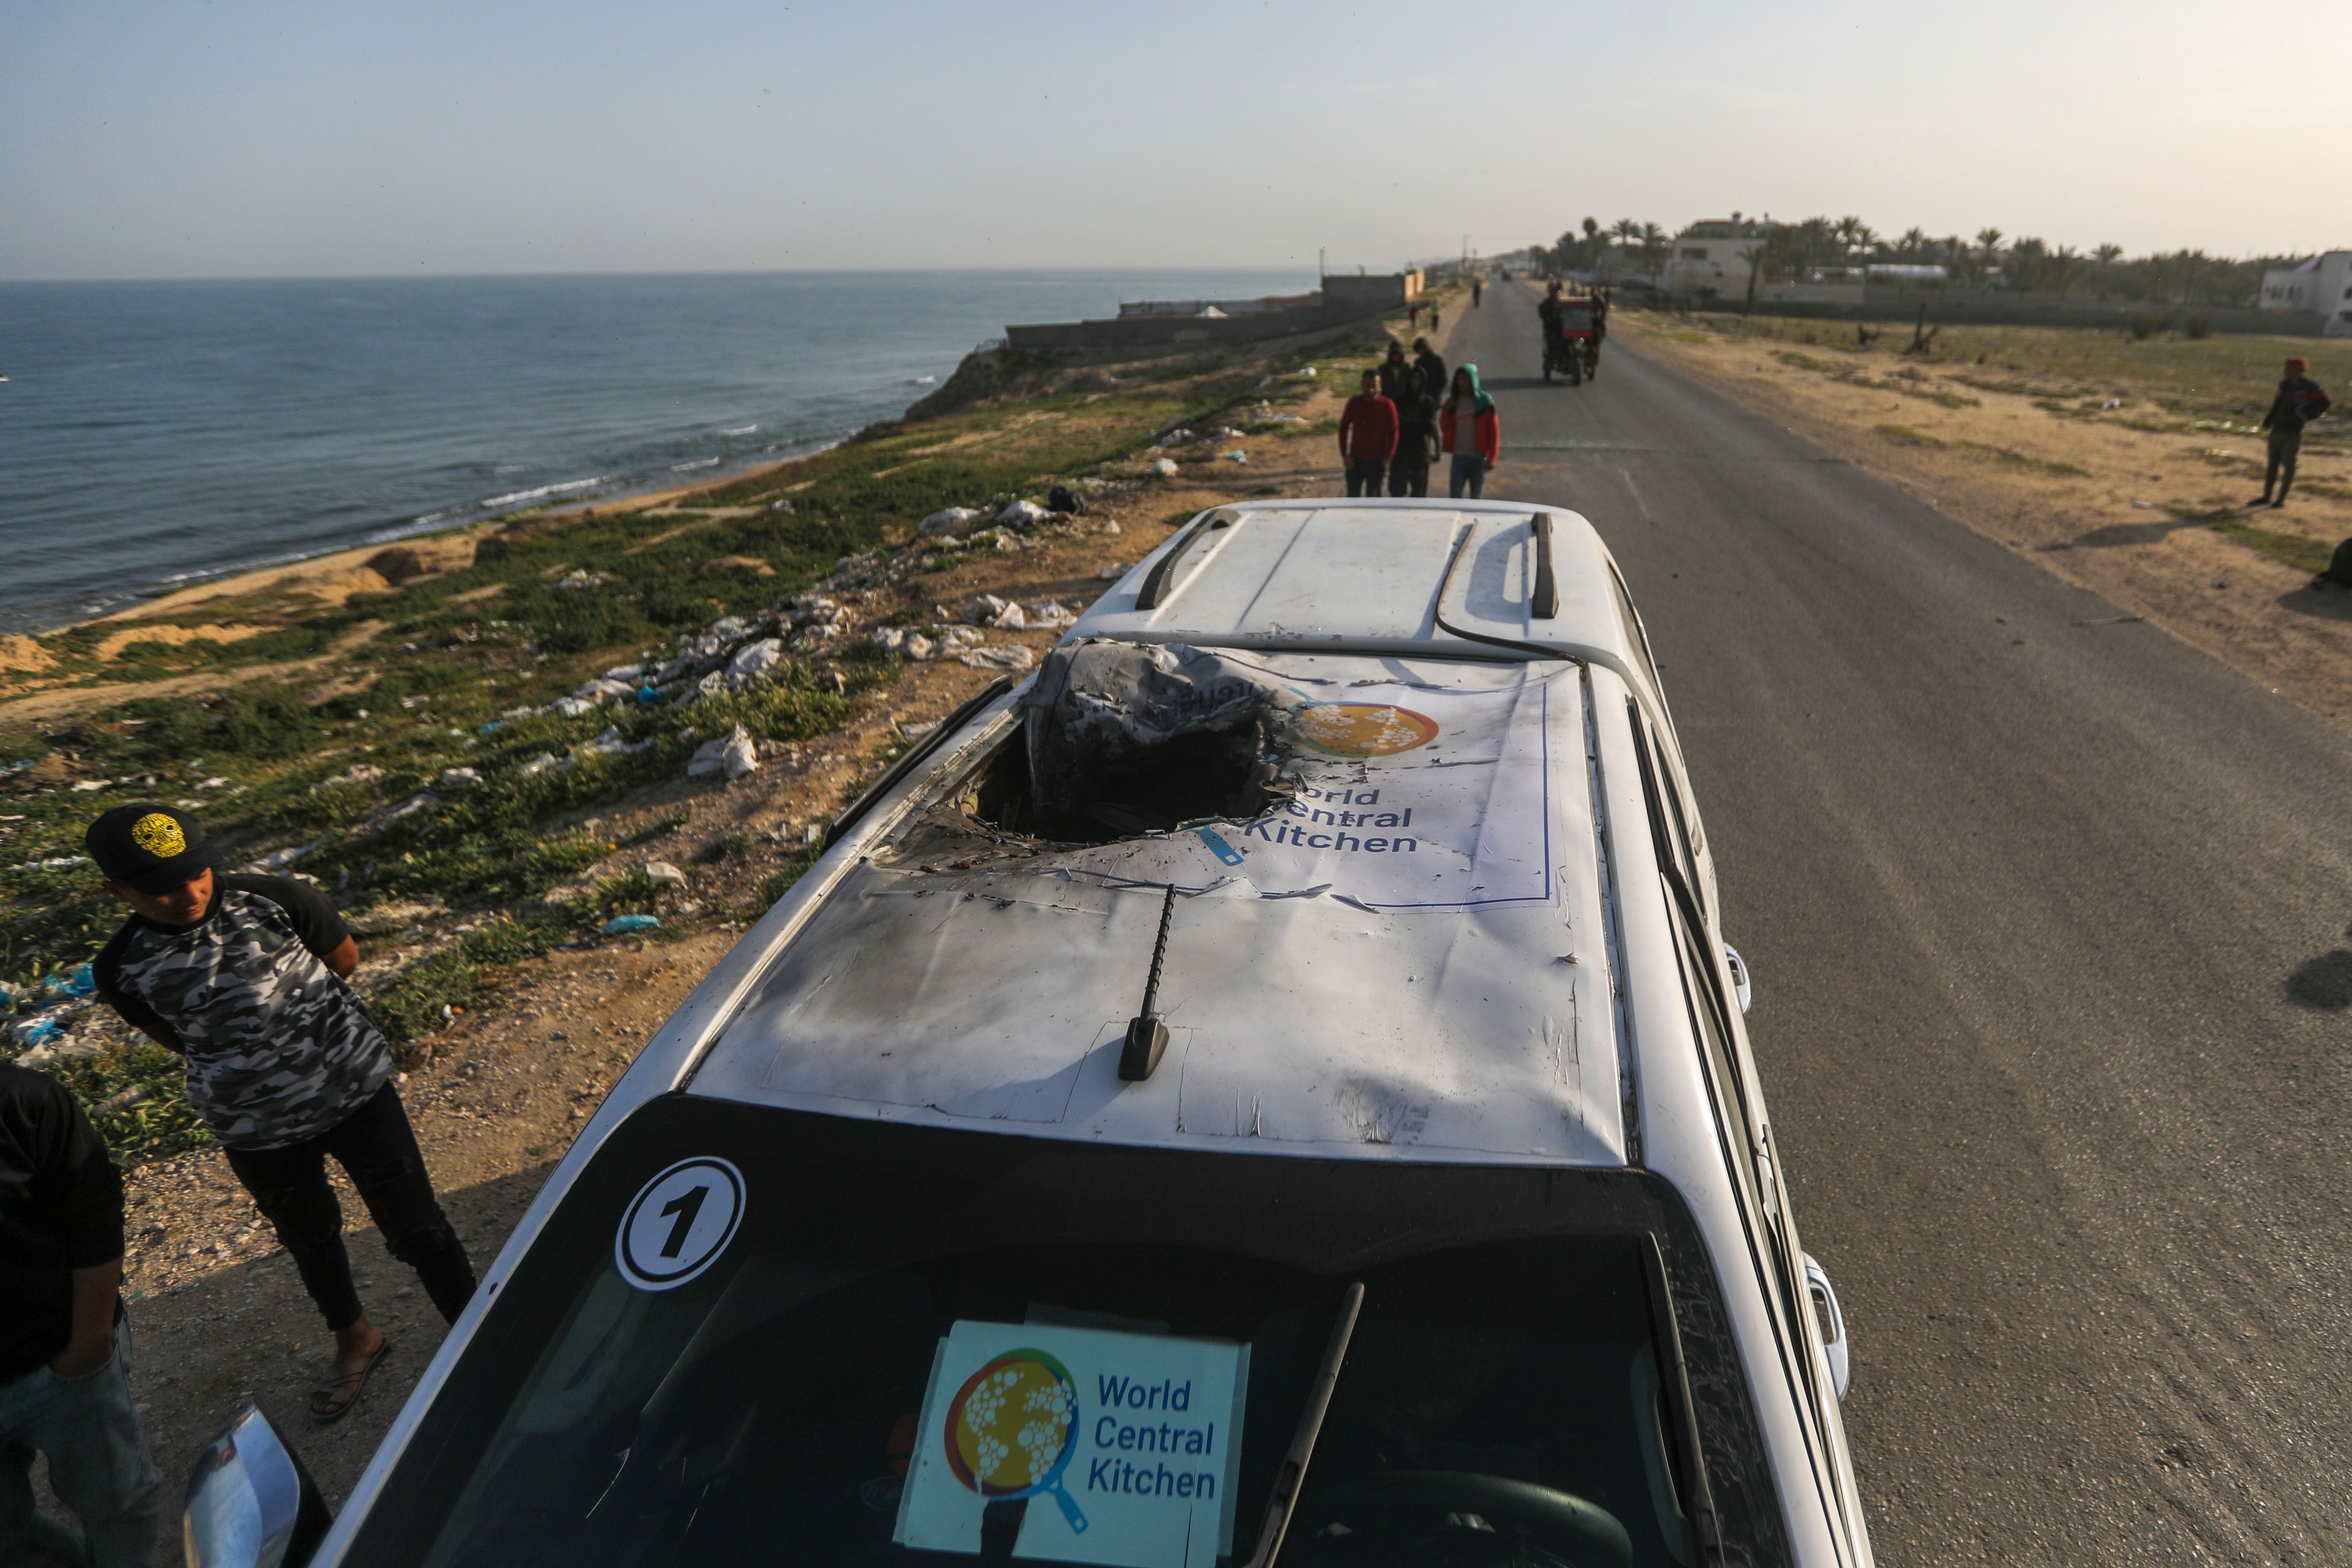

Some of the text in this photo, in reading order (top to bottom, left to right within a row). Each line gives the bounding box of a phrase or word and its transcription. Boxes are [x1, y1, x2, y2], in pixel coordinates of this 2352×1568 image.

[1286, 800, 1412, 828] entral
[1305, 788, 1380, 806] orld
[1244, 818, 1417, 853] Kitchen
[659, 1185, 710, 1259] 1
[1098, 1374, 1191, 1412] World
[1094, 1415, 1214, 1455] Central
[1087, 1457, 1215, 1499] Kitchen
